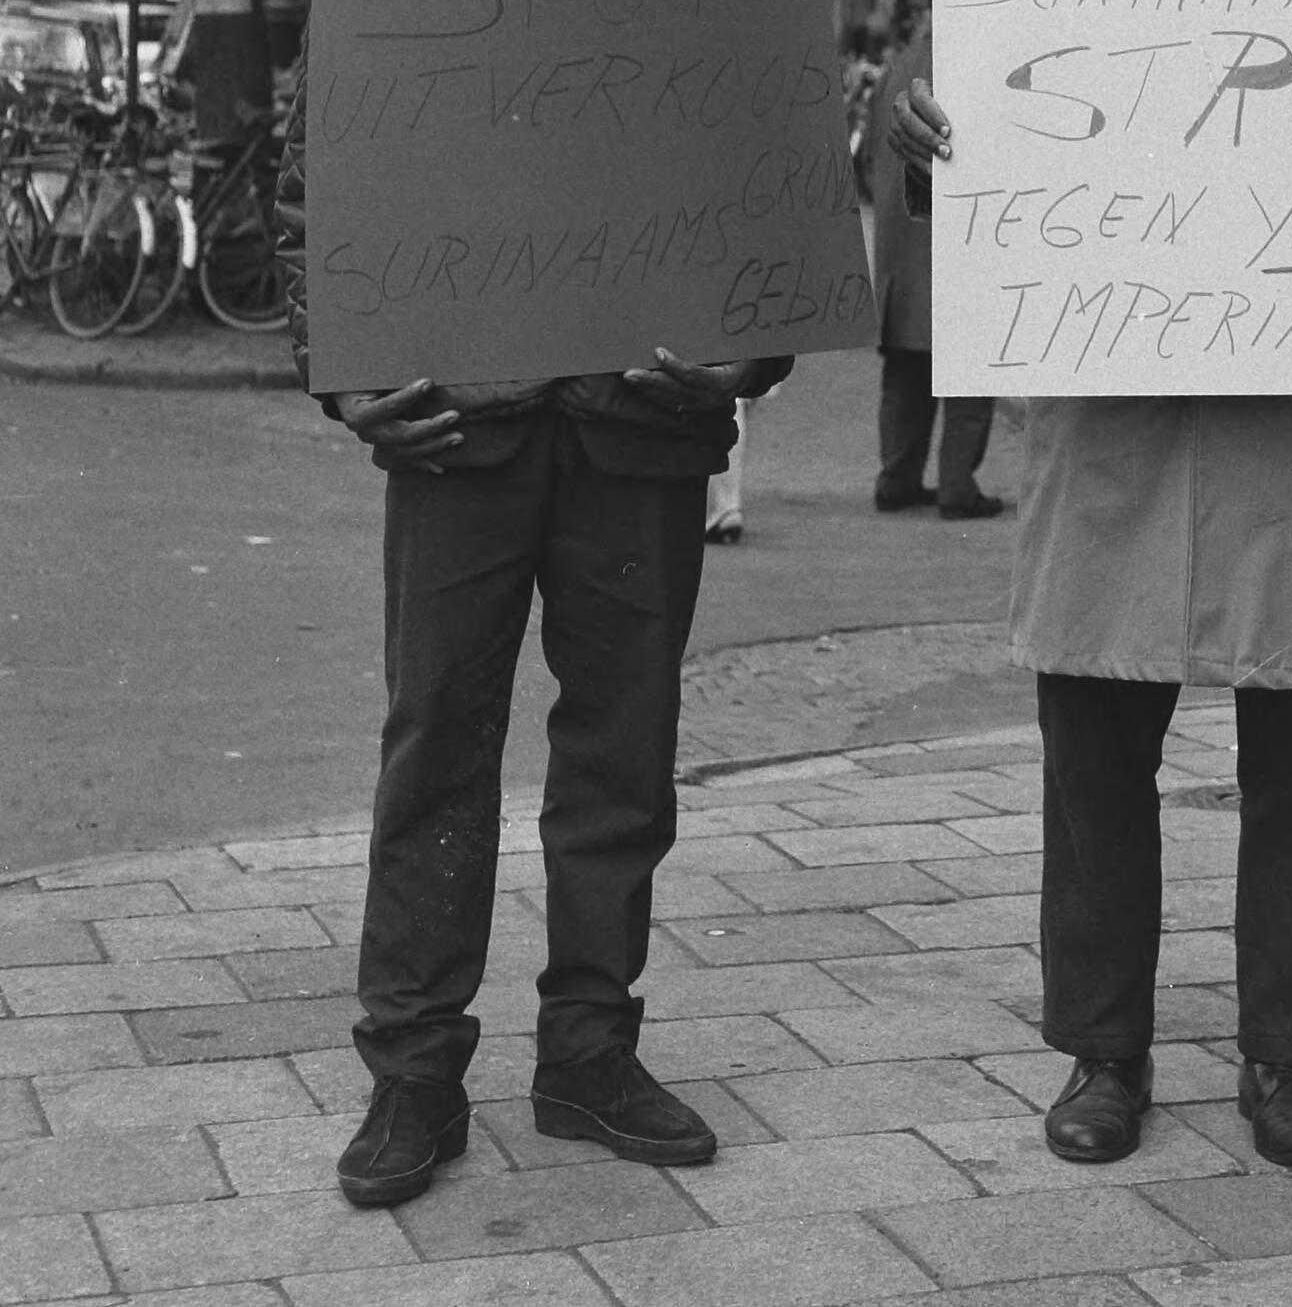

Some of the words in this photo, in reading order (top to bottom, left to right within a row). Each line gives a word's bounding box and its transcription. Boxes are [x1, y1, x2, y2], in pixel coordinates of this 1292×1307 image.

[322, 46, 830, 145] UITVERKOOP
[323, 203, 736, 317] SURINAAMS
[943, 184, 1208, 248] TEGEN
